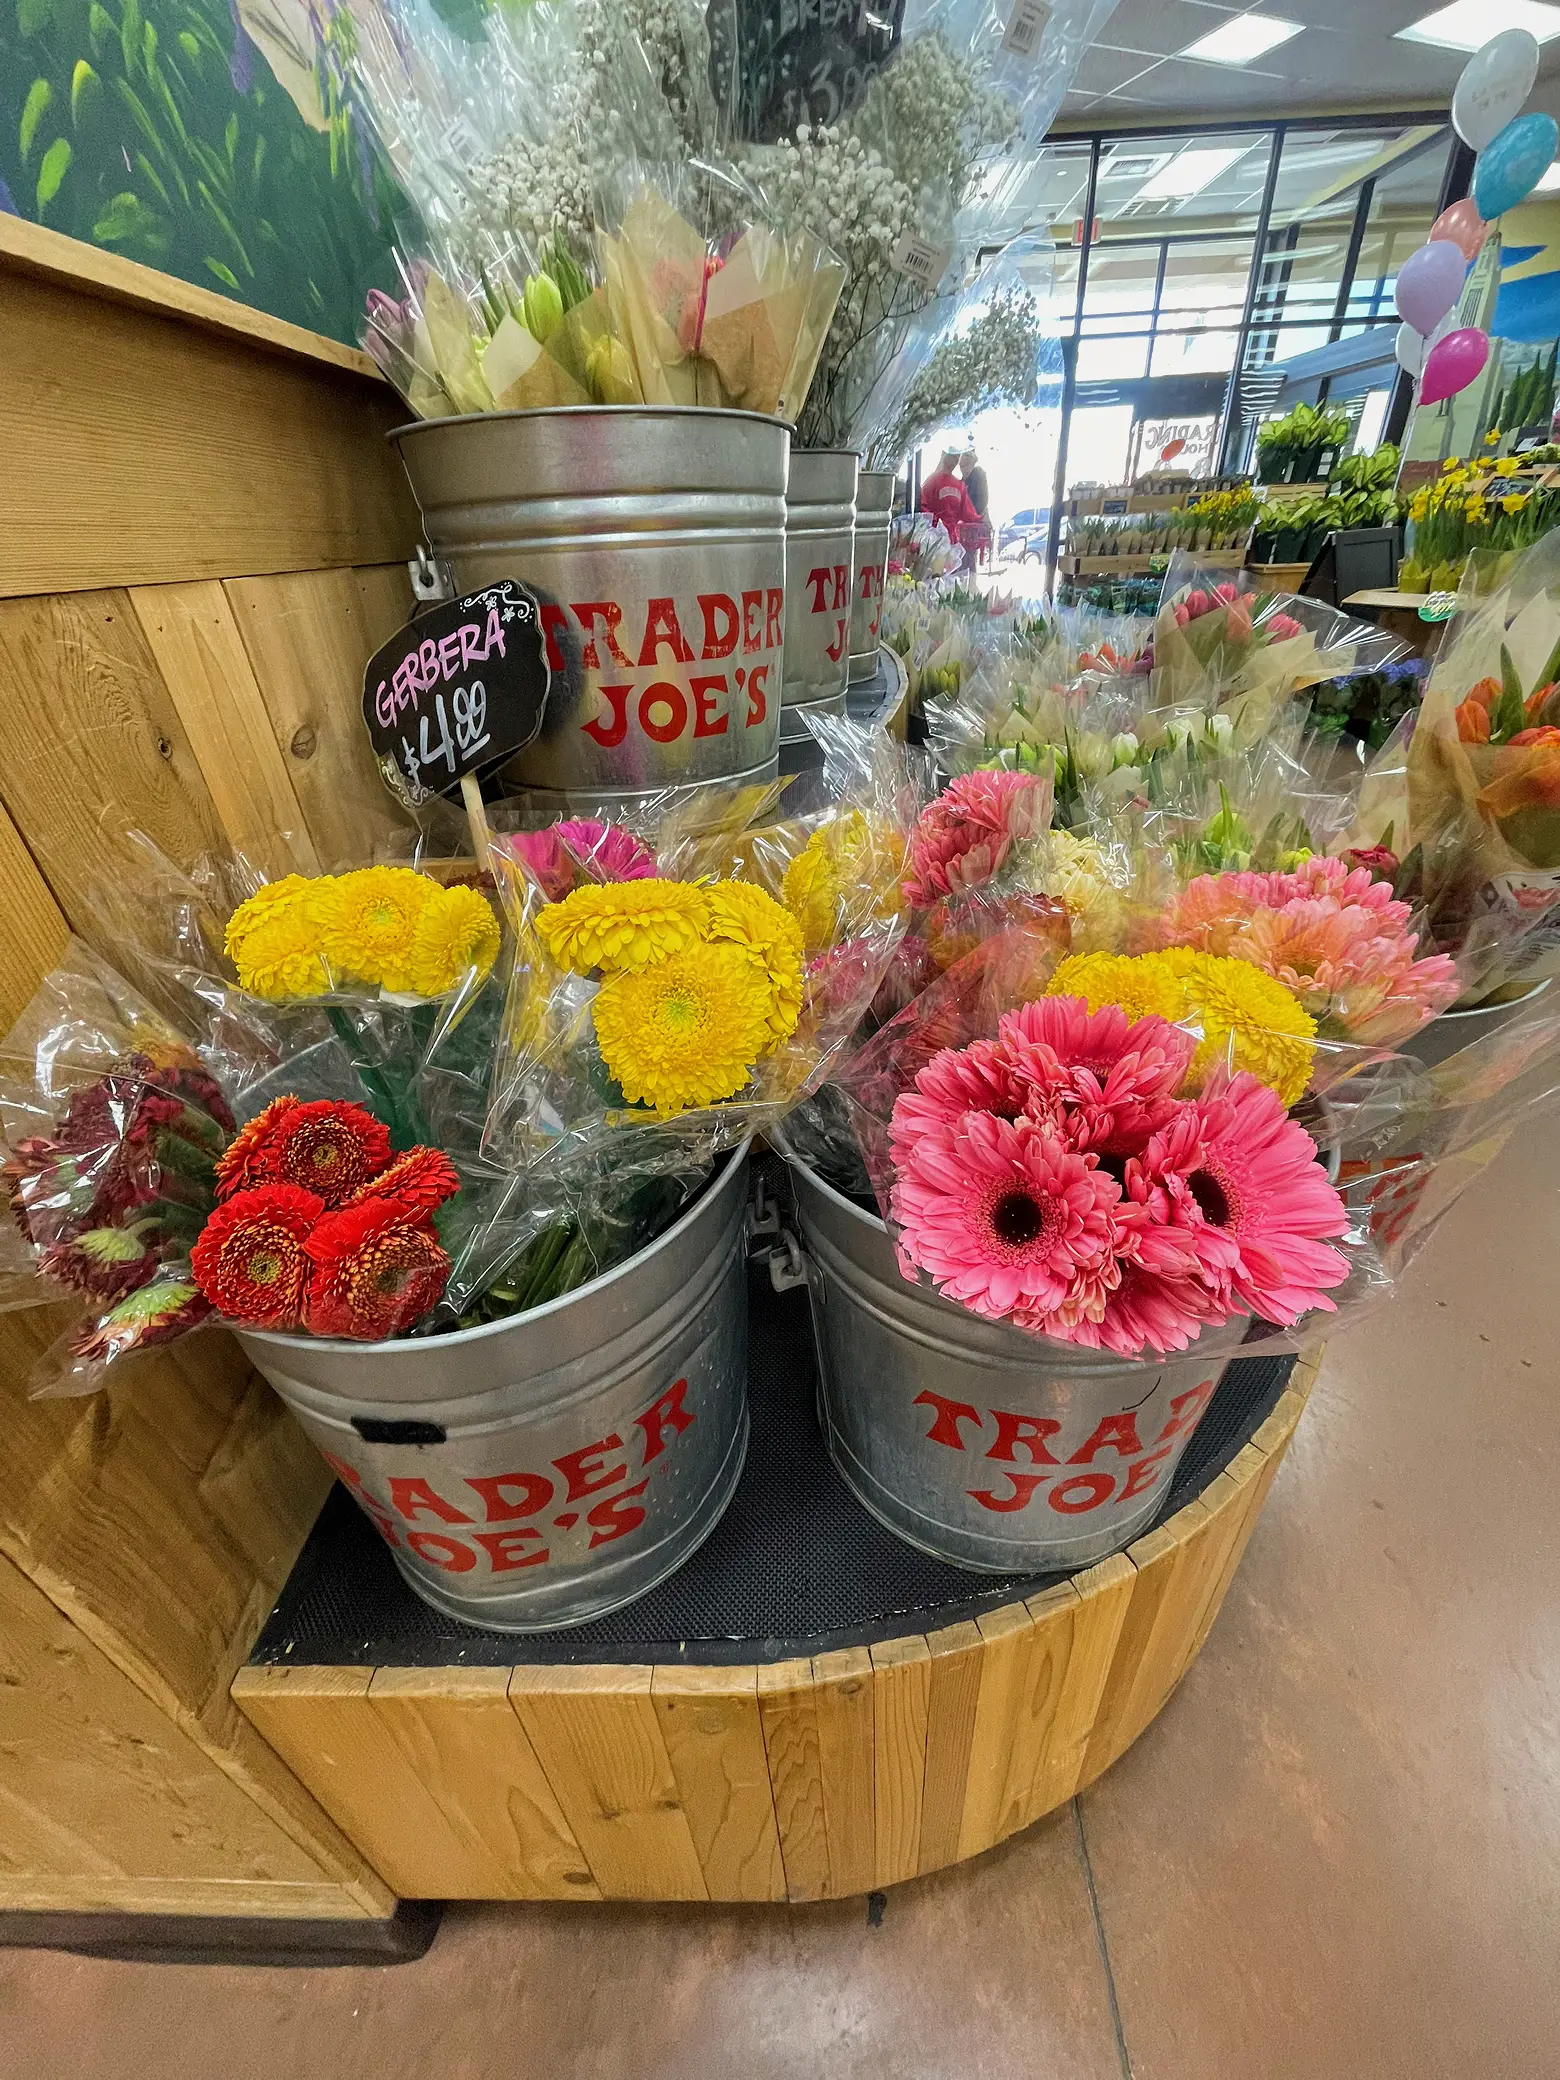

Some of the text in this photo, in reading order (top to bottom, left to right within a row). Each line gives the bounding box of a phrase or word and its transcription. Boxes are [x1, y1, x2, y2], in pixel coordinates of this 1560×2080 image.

[375, 608, 507, 729] GERBERA
[580, 664, 769, 748] JOE'S
[911, 1379, 1214, 1465] TRAD
